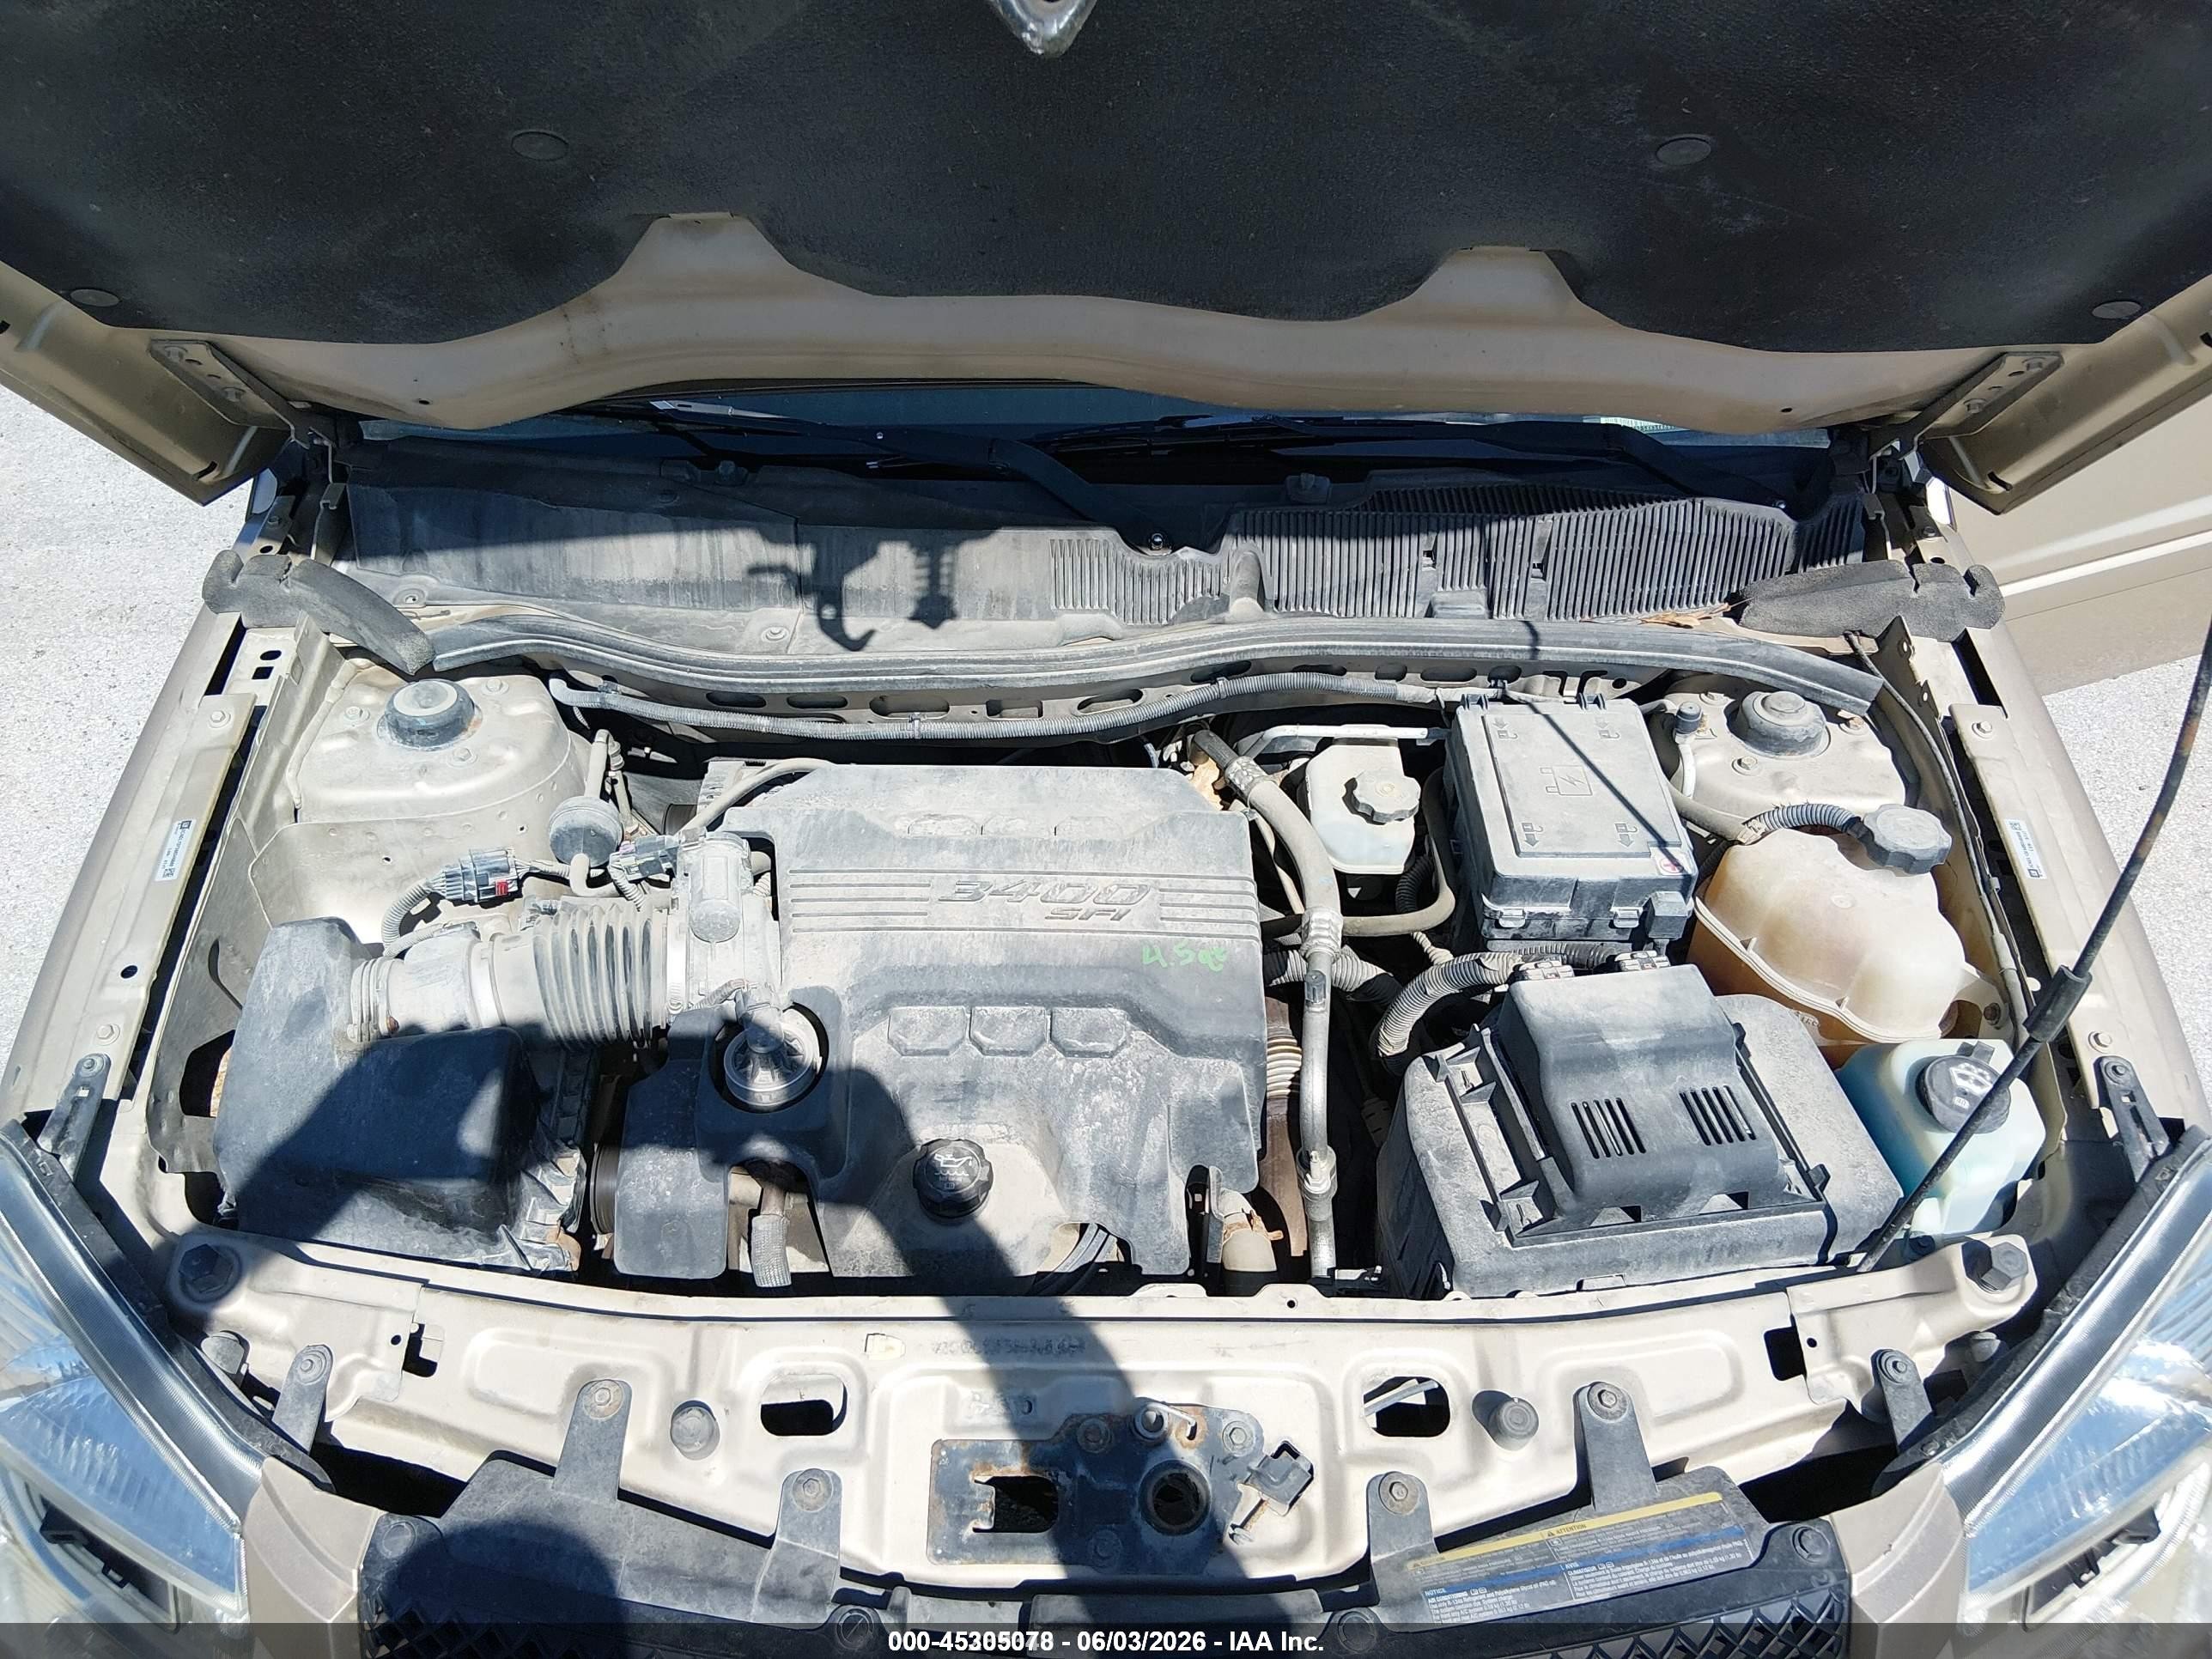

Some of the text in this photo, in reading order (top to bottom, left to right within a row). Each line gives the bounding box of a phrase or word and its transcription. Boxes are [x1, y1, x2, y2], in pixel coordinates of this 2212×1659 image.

[939, 879, 1152, 906] 3400
[1045, 908, 1132, 921] SFI
[1556, 1523, 1587, 1534] ATTENTION
[1425, 1588, 1447, 1596] NOTICE
